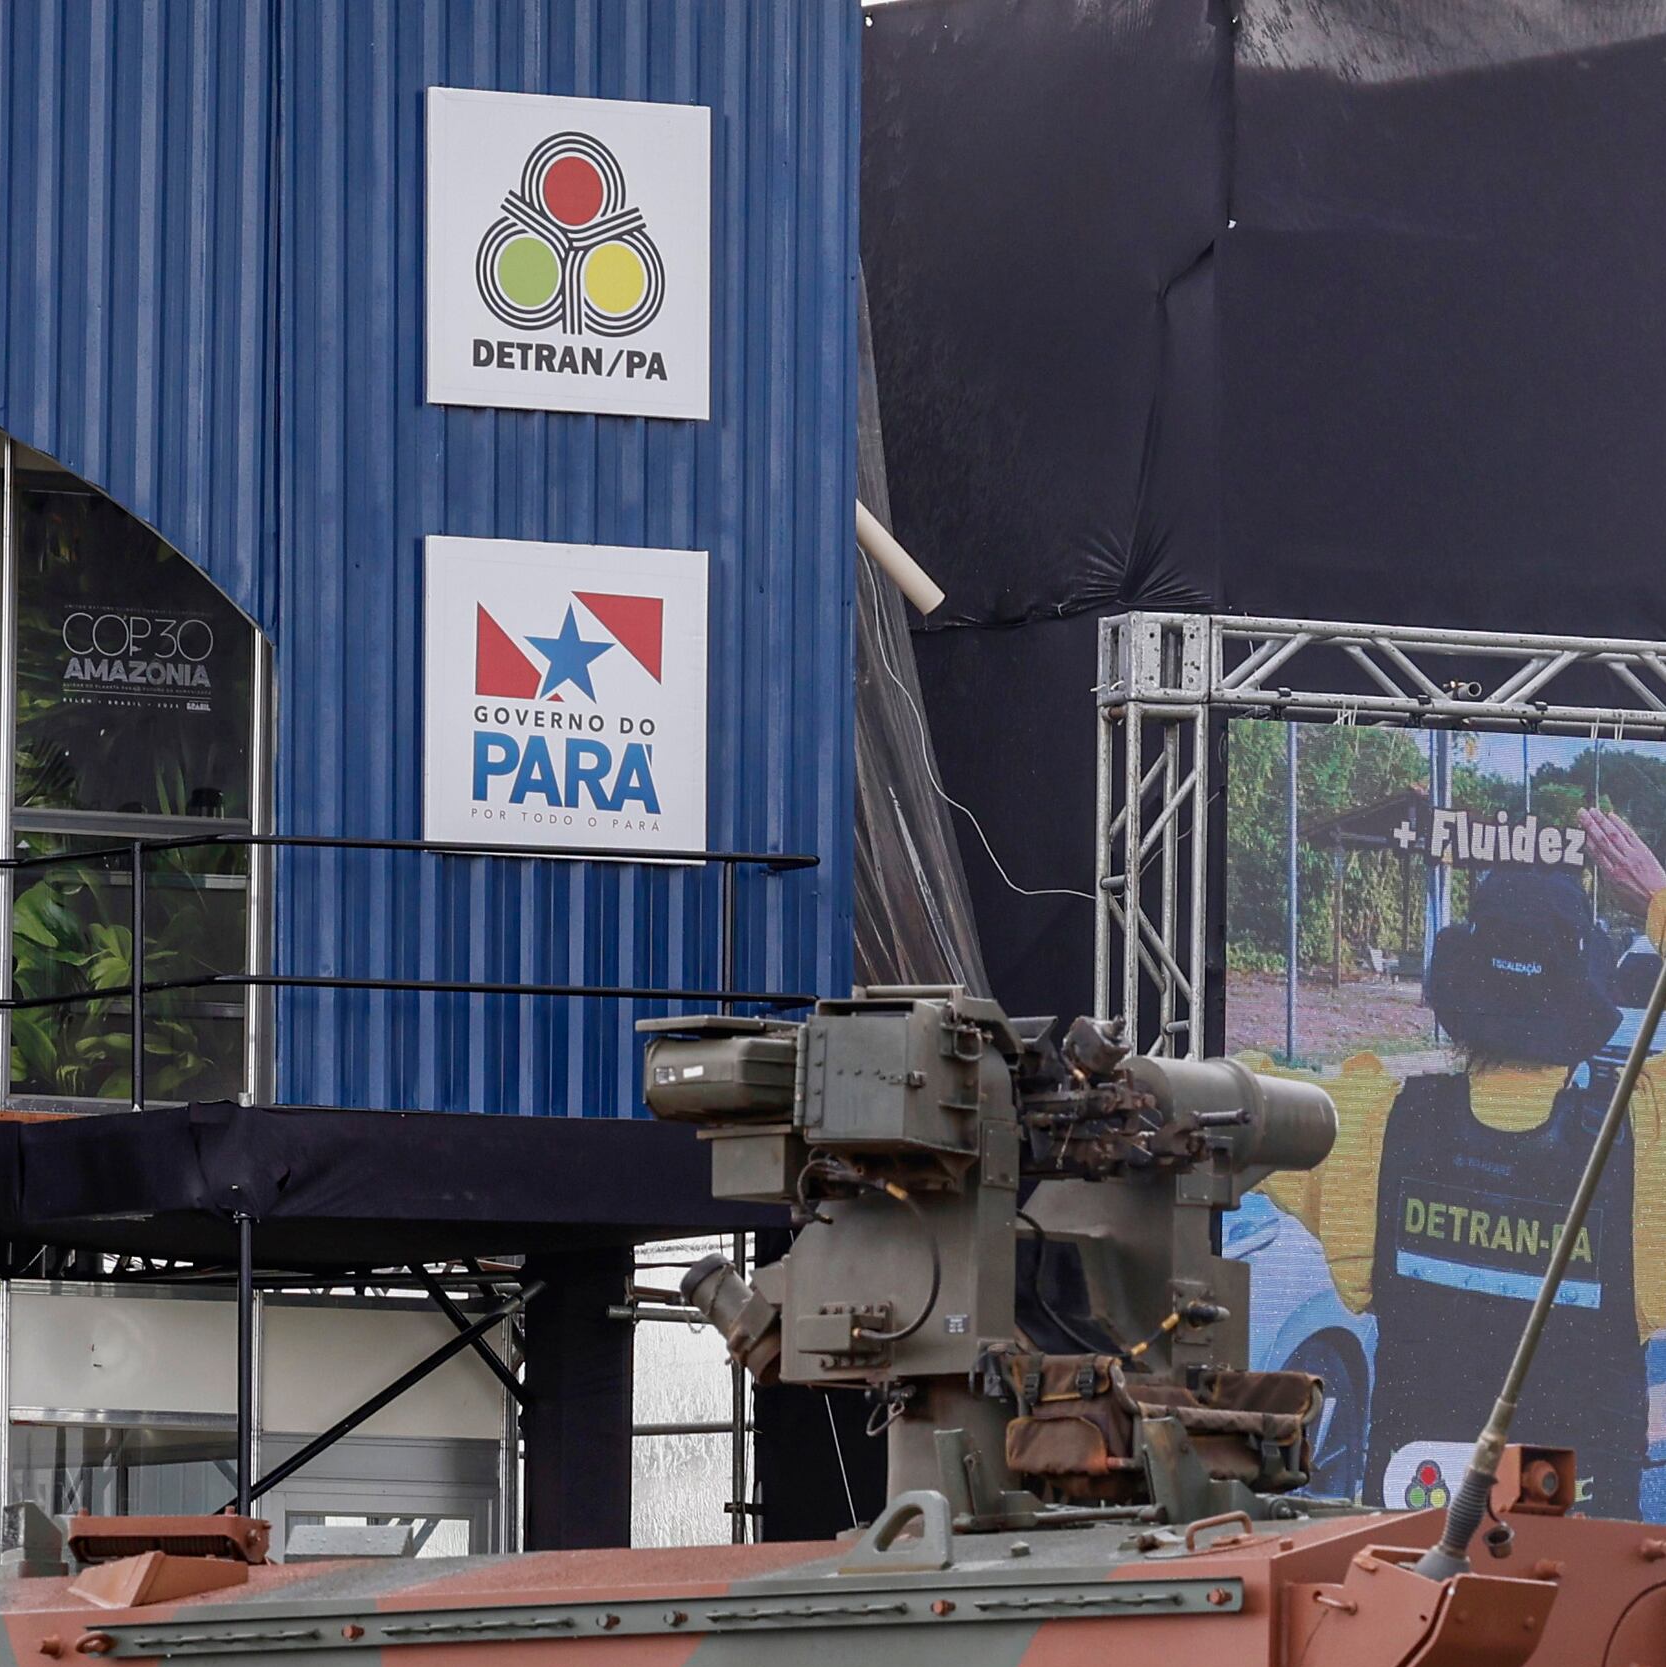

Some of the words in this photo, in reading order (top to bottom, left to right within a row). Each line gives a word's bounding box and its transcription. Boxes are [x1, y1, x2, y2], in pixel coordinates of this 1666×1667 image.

[472, 337, 669, 382] DETRAN/PA
[62, 612, 214, 662] COP30
[63, 656, 212, 688] AMAZÔNIA
[473, 704, 605, 733] GOVERNO
[619, 716, 656, 737] DO
[472, 729, 662, 815] PARÁ
[471, 807, 506, 821] POR
[521, 811, 574, 827] TODO
[587, 817, 597, 828] O
[612, 818, 661, 833] PARÁ
[1431, 808, 1586, 866] Fluidez
